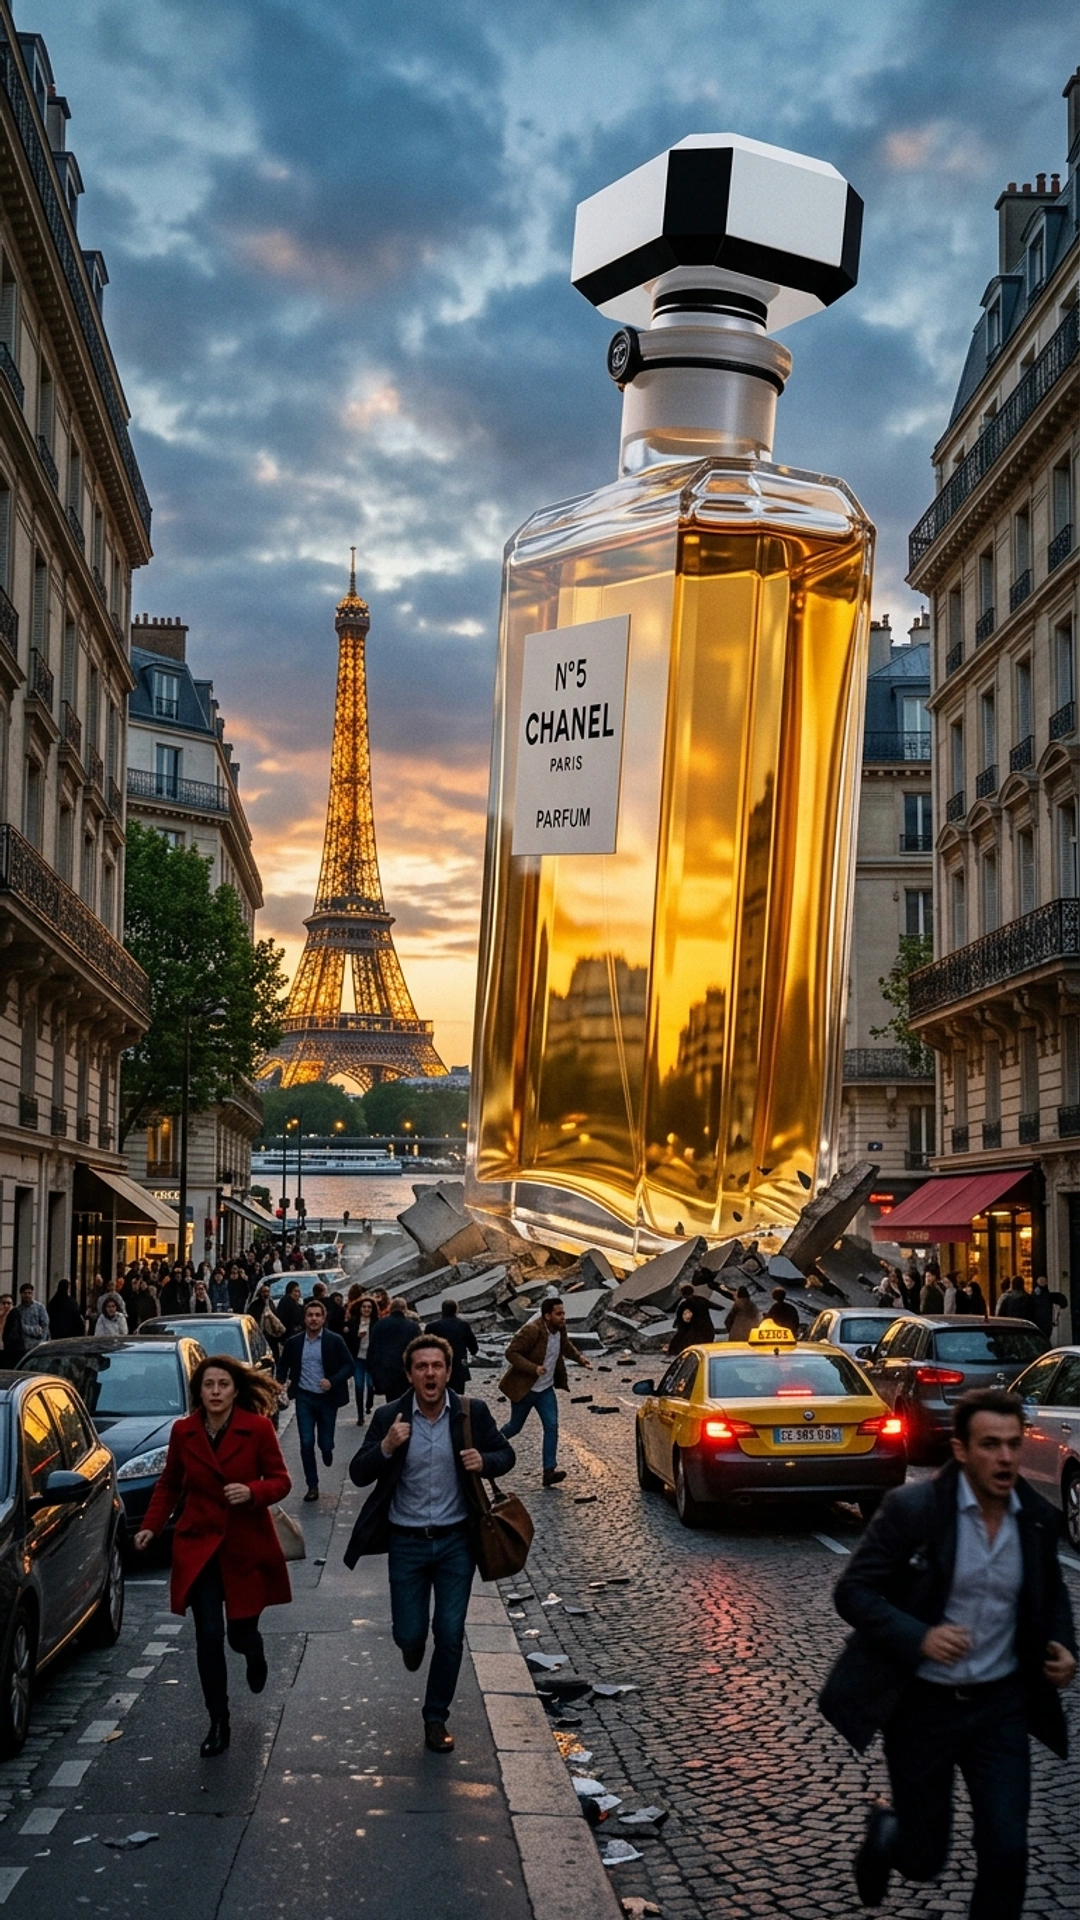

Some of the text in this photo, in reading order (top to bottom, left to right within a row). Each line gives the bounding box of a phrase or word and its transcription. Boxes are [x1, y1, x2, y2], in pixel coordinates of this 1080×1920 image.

[555, 659, 587, 691] N°5
[525, 703, 615, 745] CHANEL
[549, 755, 583, 773] PARIS
[535, 807, 591, 829] PARFUM
